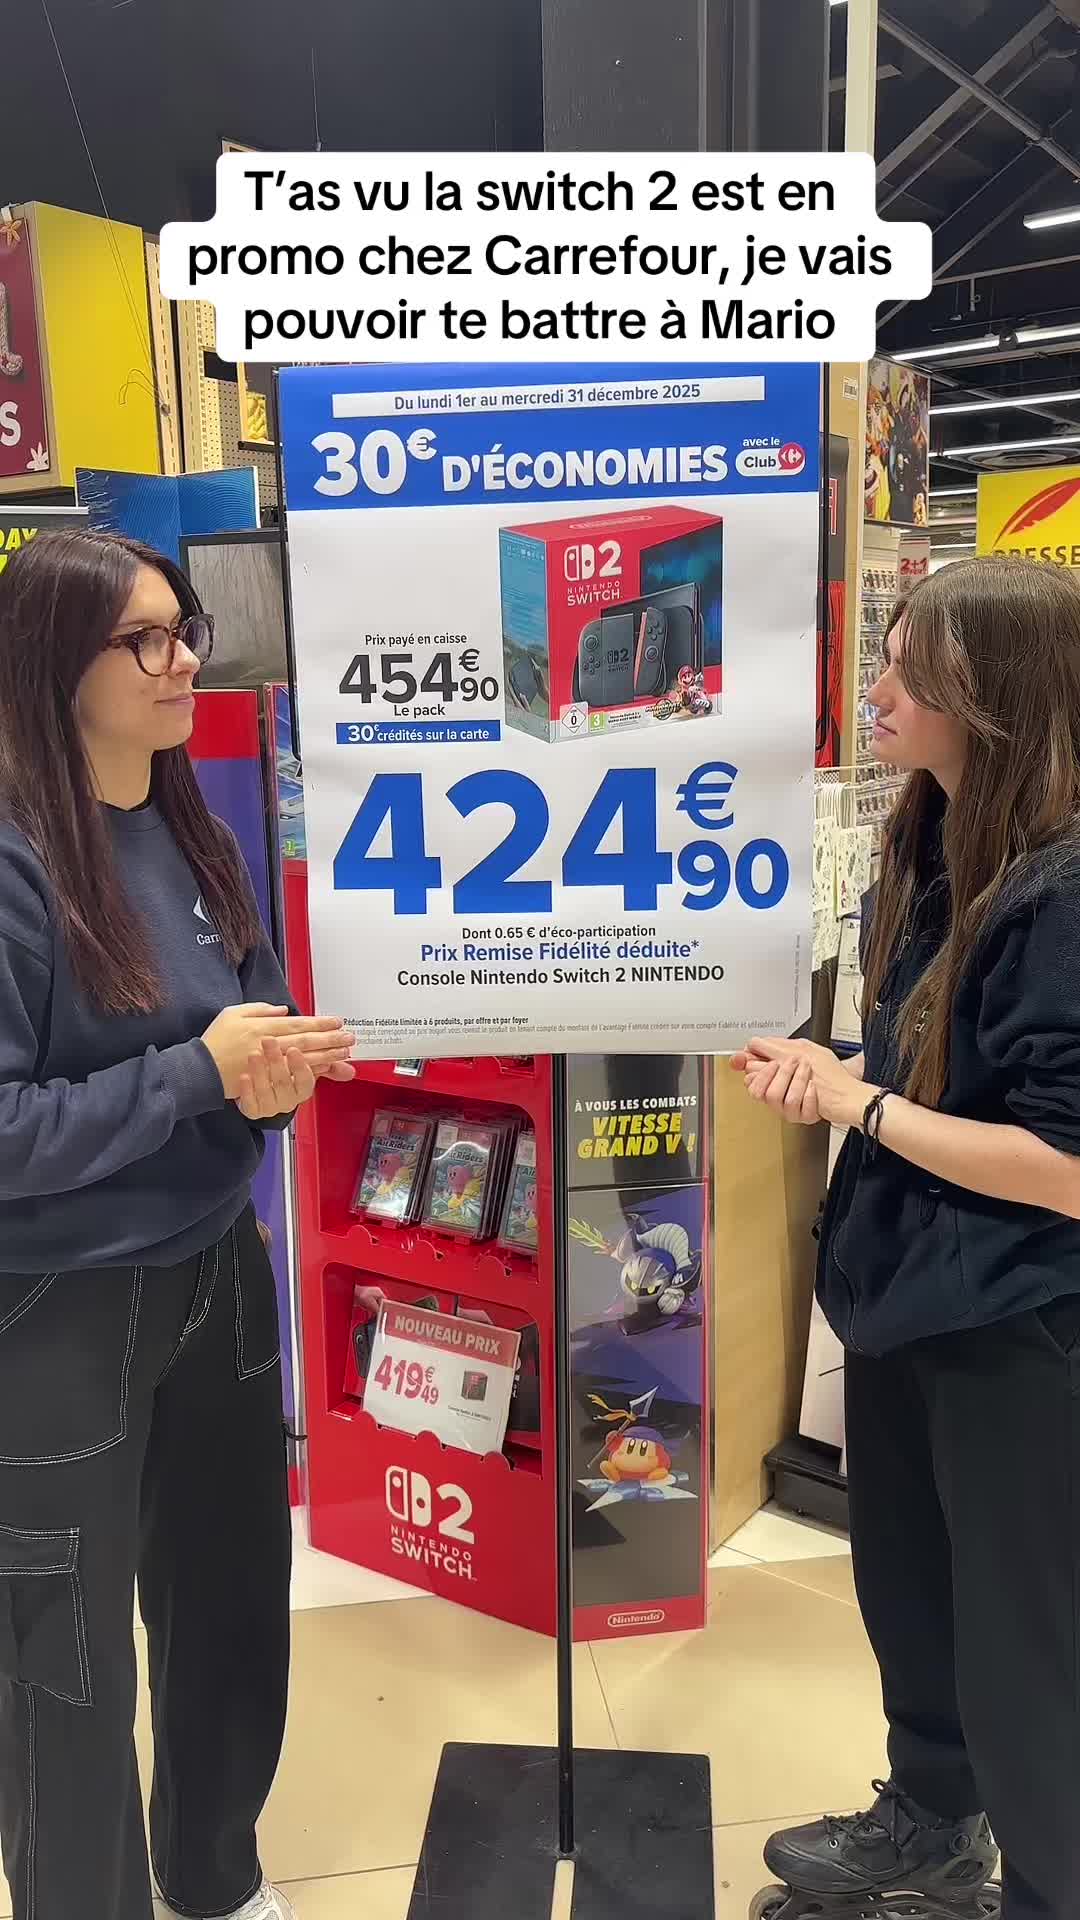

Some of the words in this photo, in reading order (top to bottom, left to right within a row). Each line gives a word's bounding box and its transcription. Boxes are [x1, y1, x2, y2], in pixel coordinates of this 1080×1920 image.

[394, 396, 414, 410] Du
[417, 394, 452, 409] lundi
[455, 393, 477, 408] 1er
[480, 395, 498, 407] au
[501, 388, 564, 406] mercredi
[567, 389, 584, 403] 31
[587, 386, 659, 402] décembre
[662, 384, 701, 399] 2025
[742, 438, 769, 447] avec
[770, 436, 780, 446] le
[442, 443, 728, 492] D'ÉCONOMIES
[743, 456, 777, 468] Club
[0, 528, 38, 550] AY
[598, 540, 622, 578] 2
[567, 580, 621, 594] NINTENDO
[567, 588, 621, 607] SWITCH
[365, 634, 386, 645] Prix
[388, 633, 415, 647] payé
[417, 635, 431, 644] en
[433, 632, 468, 644] caisse
[393, 704, 410, 716] Le
[413, 703, 446, 719] pack
[593, 713, 601, 727] 3
[377, 728, 423, 741] crédités
[425, 730, 445, 740] sur
[446, 728, 458, 740] la
[460, 729, 490, 741] carte
[461, 927, 492, 940] Dont
[494, 927, 523, 939] 0.65
[526, 926, 536, 938] €
[538, 924, 656, 942] d'éco-participation
[420, 944, 458, 962] Prix
[463, 942, 534, 961] Remise
[539, 940, 611, 961] Fidélité
[397, 970, 466, 986] Console
[470, 968, 549, 986] Nintendo
[552, 966, 610, 984] Switch
[614, 967, 626, 982] 2
[631, 964, 725, 982] NINTENDO
[428, 1018, 433, 1026] 6
[463, 1018, 474, 1026] par
[475, 1016, 492, 1025] offre
[492, 1016, 500, 1025] et
[500, 1017, 511, 1026] par
[512, 1016, 529, 1026] foyer
[574, 1099, 583, 1113] À
[584, 1100, 617, 1112] VOUS
[619, 1098, 640, 1111] LES
[641, 1095, 697, 1110] COMBATS
[592, 1112, 682, 1137] VITESSE
[577, 1135, 659, 1159] GRAND
[665, 1133, 682, 1154] V
[685, 1132, 696, 1153] !
[394, 1315, 462, 1345] NOUVEAU
[464, 1333, 501, 1355] PRIX
[436, 1483, 475, 1545] 2
[390, 1524, 472, 1562] NINTENDO
[391, 1536, 473, 1581] SWITCH
[612, 1611, 661, 1626] Nintendo
